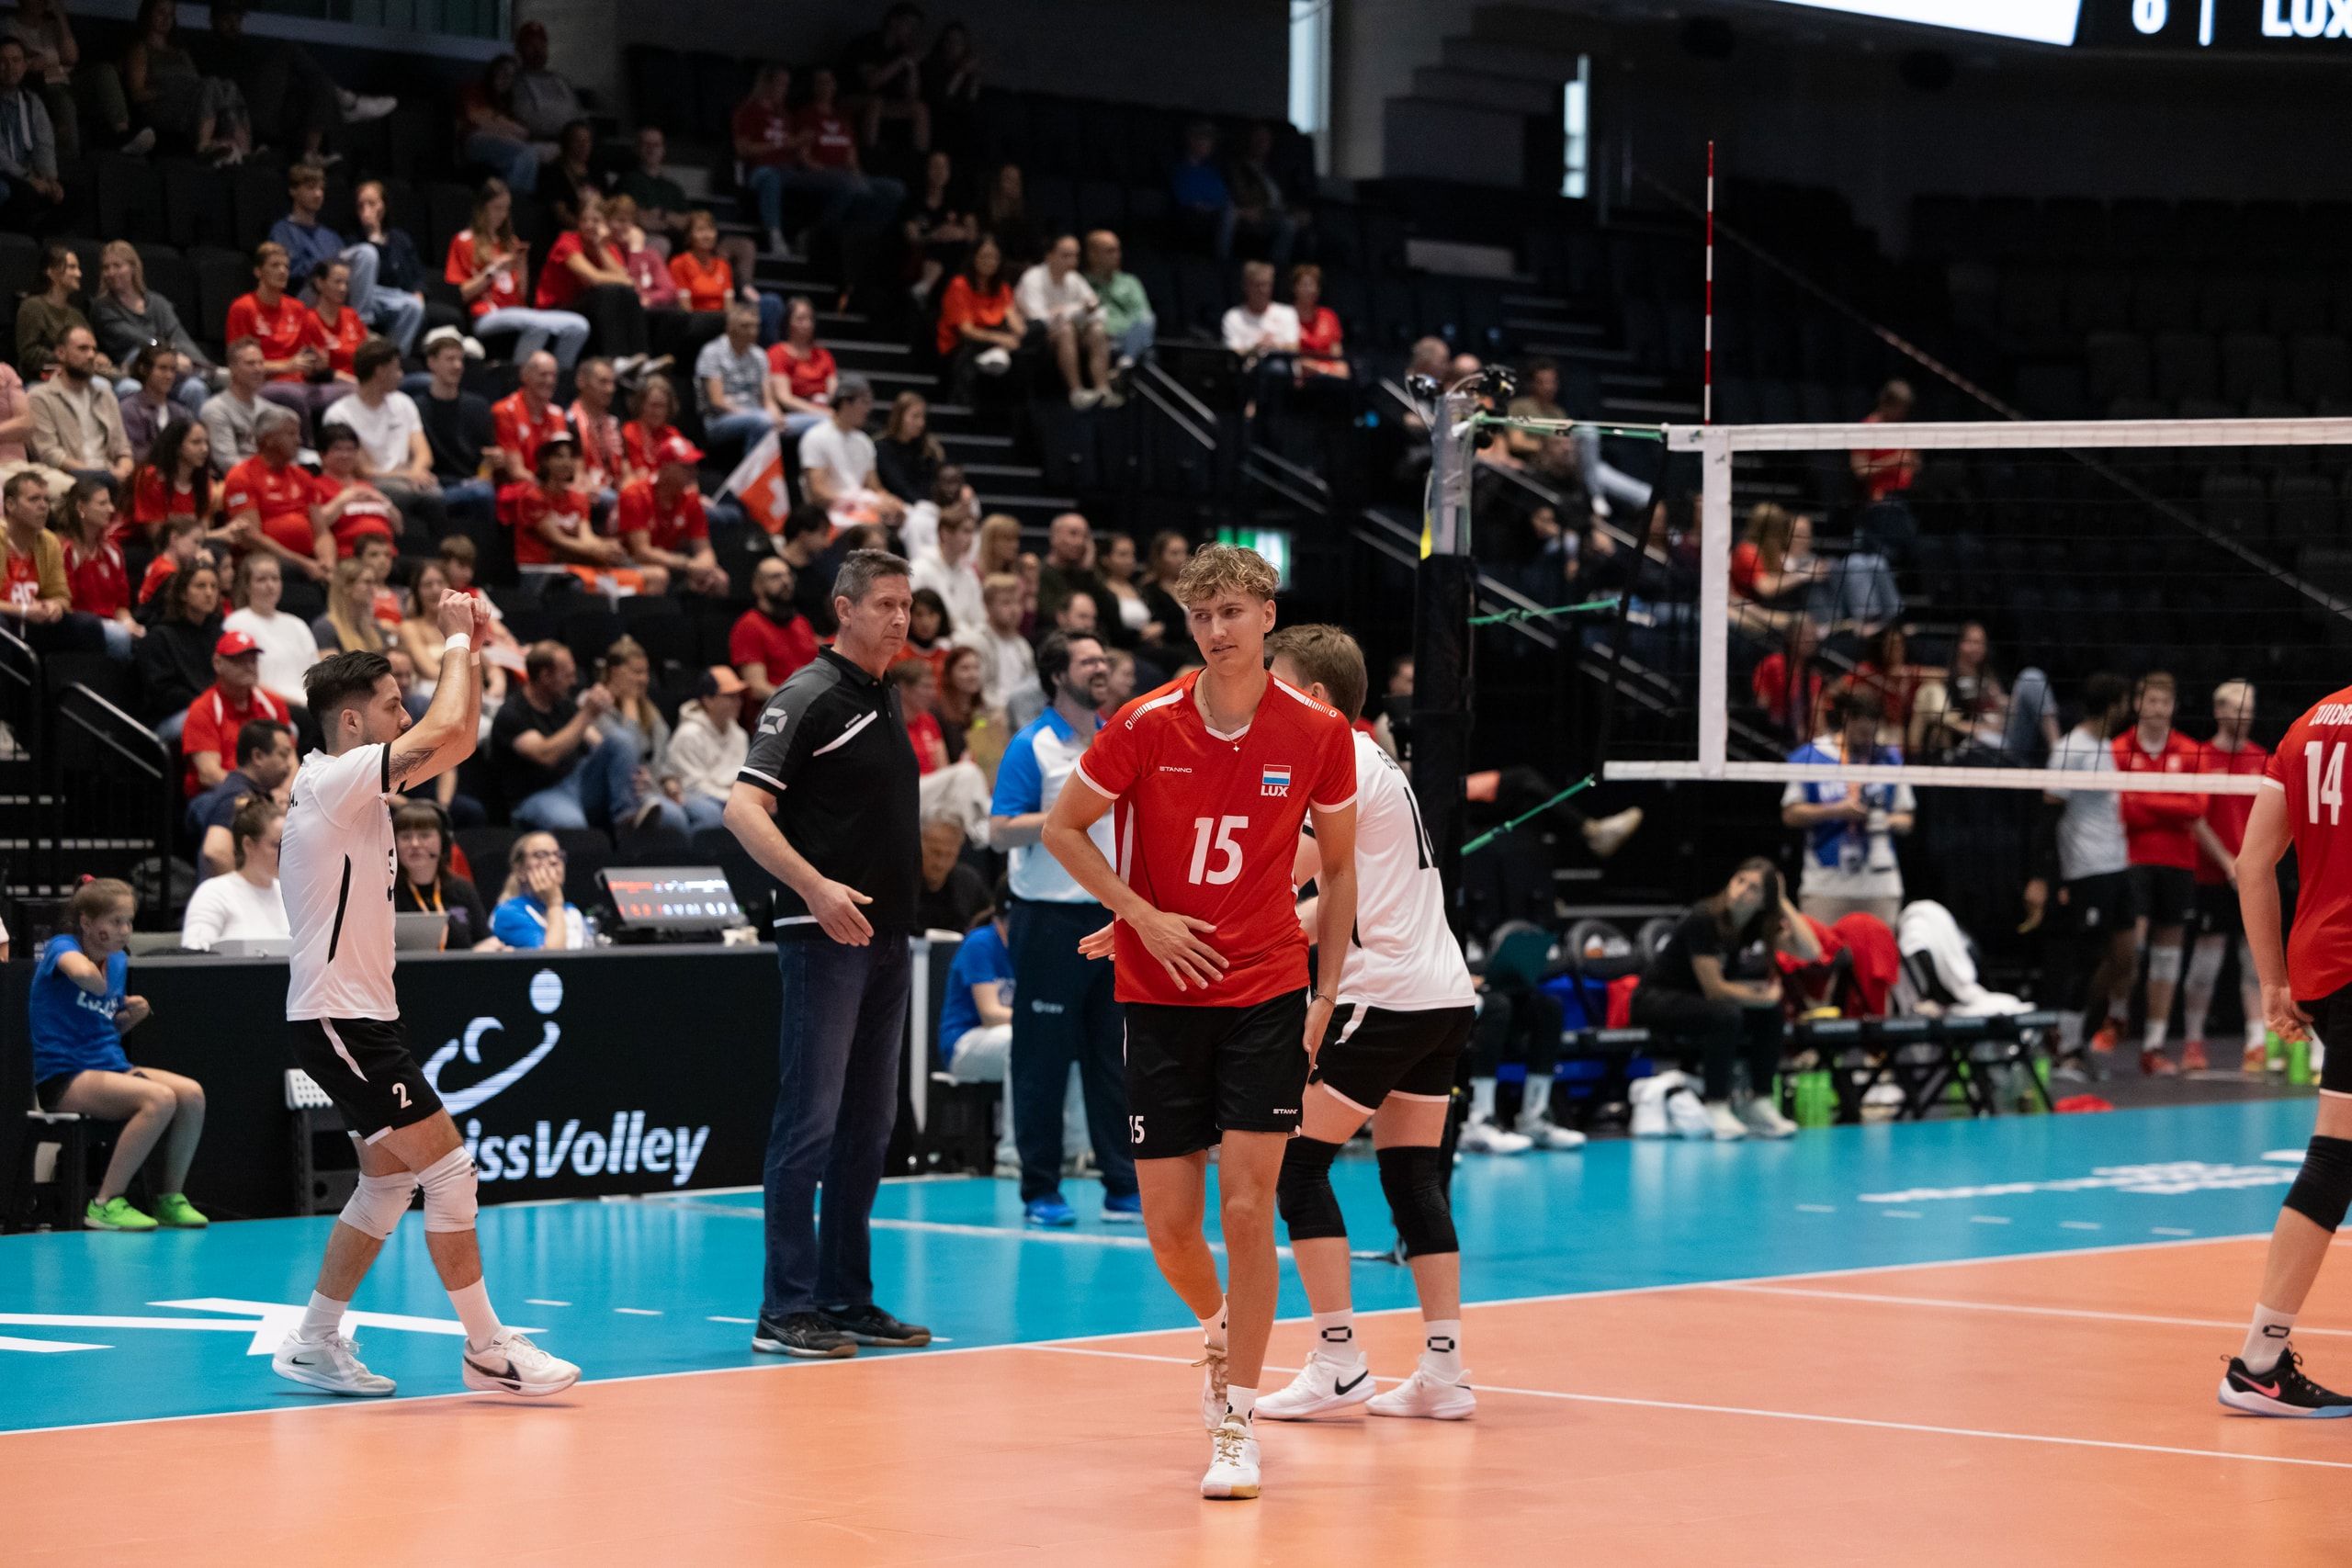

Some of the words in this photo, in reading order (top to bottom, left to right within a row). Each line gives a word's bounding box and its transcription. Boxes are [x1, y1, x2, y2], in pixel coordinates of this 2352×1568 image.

[2261, 0, 2352, 38] LUX
[1159, 765, 1193, 773] STANNO
[2304, 740, 2347, 826] 14
[1261, 784, 1289, 797] LUX
[1188, 815, 1249, 886] 15
[391, 1082, 413, 1110] 2
[462, 1110, 710, 1187] issVolley
